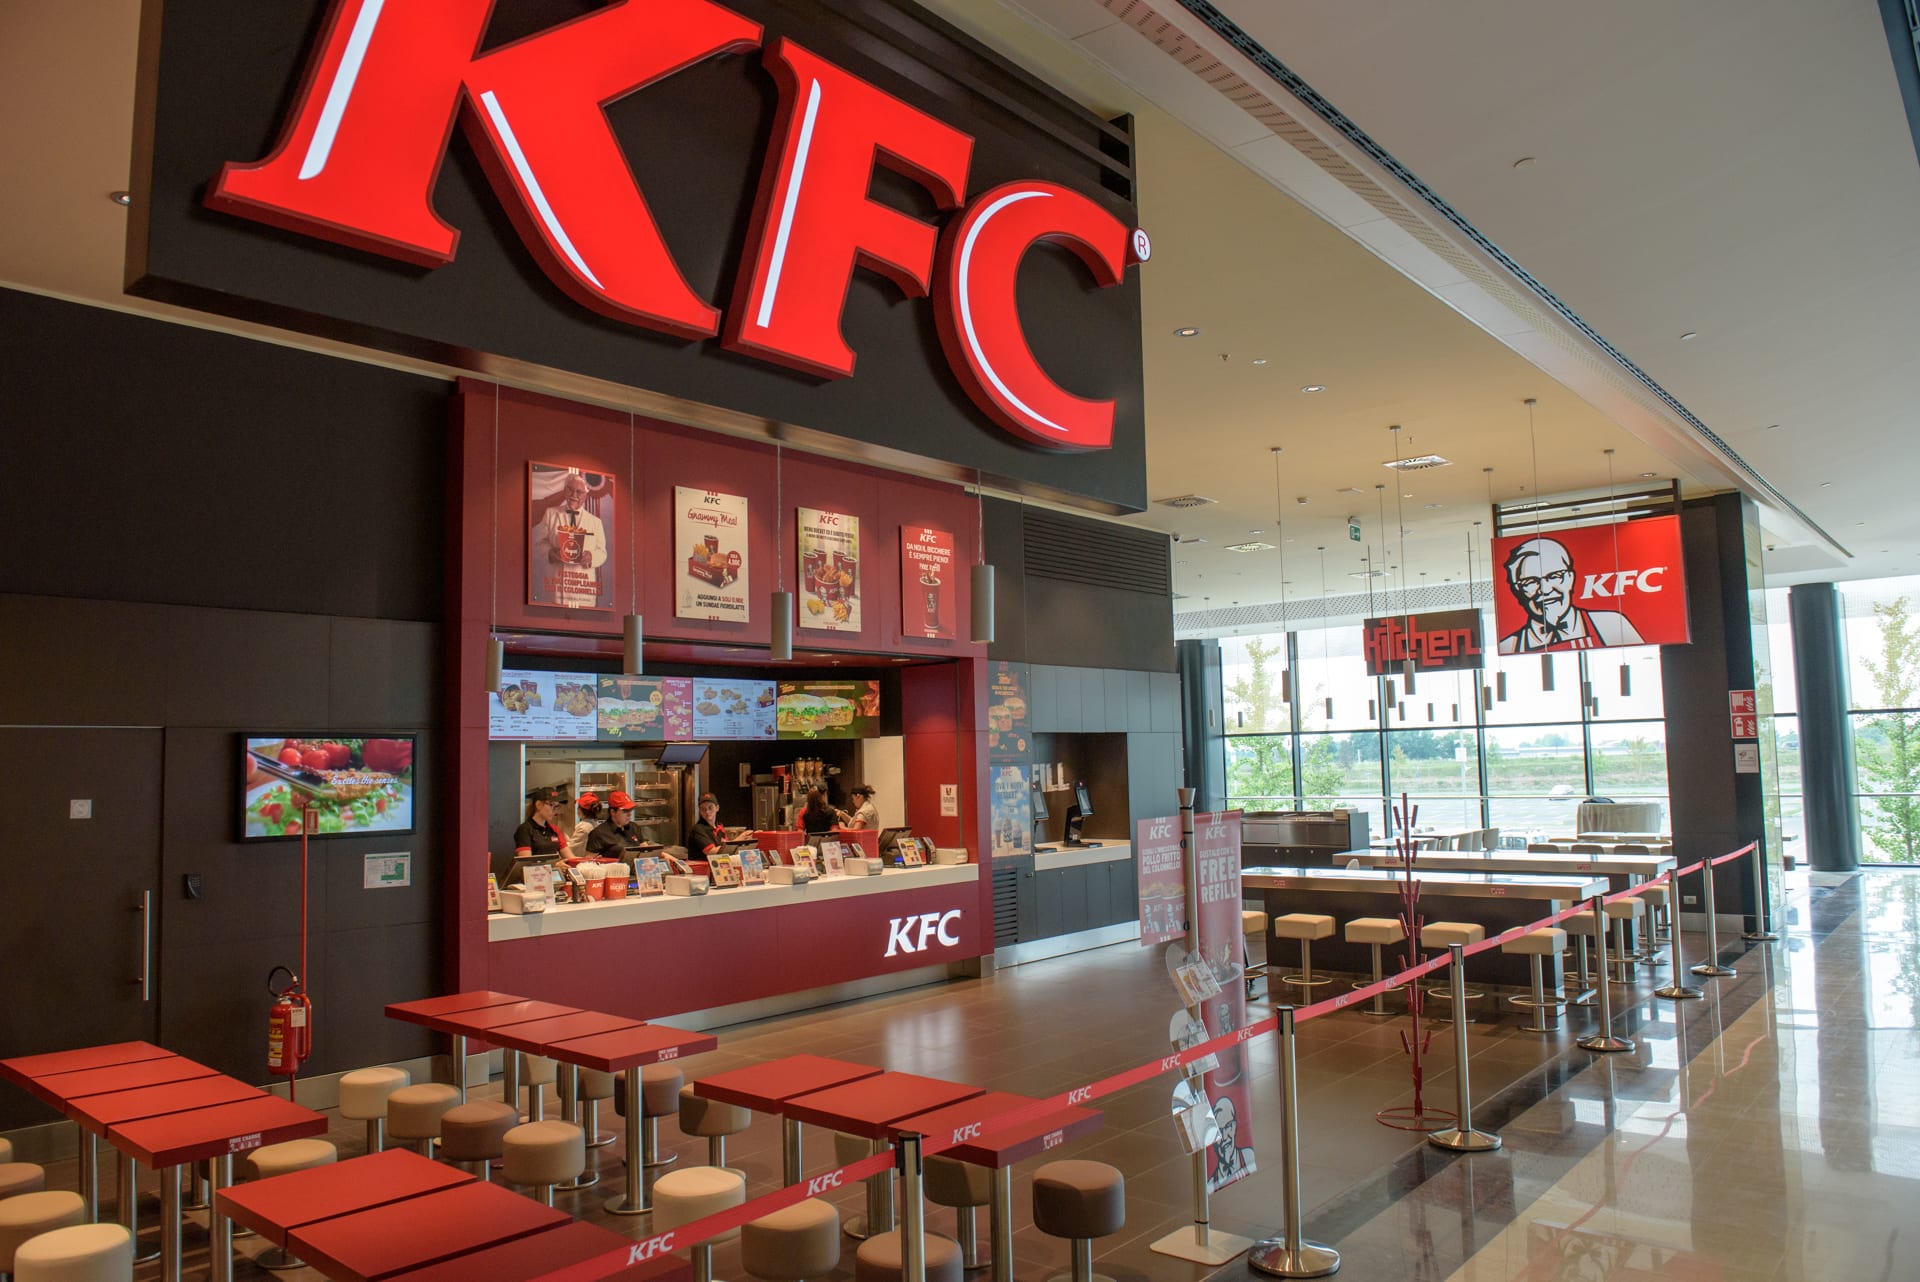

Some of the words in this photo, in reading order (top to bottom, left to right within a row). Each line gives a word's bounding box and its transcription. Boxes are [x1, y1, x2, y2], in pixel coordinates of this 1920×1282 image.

[203, 0, 1128, 450] KFC
[704, 496, 721, 506] KFC
[720, 513, 738, 526] Meal
[819, 514, 840, 526] KFC
[906, 542, 914, 551] DA
[919, 533, 937, 544] KFC
[1580, 567, 1666, 600] KFC
[1150, 825, 1172, 840] KFC
[1205, 825, 1227, 840] KFC
[1142, 854, 1161, 866] POLLO
[1161, 851, 1181, 863] FRITTO
[1200, 856, 1236, 885] FREE
[1201, 881, 1237, 905] REFILL
[884, 909, 962, 958] KFC
[1335, 993, 1349, 1008] KFC
[1236, 1025, 1255, 1043] KFC
[1161, 1053, 1182, 1072] KFC
[1067, 1085, 1092, 1106] KFC
[951, 1121, 982, 1145] KFC
[806, 1169, 844, 1198] KFC
[627, 1232, 675, 1267] KFC
